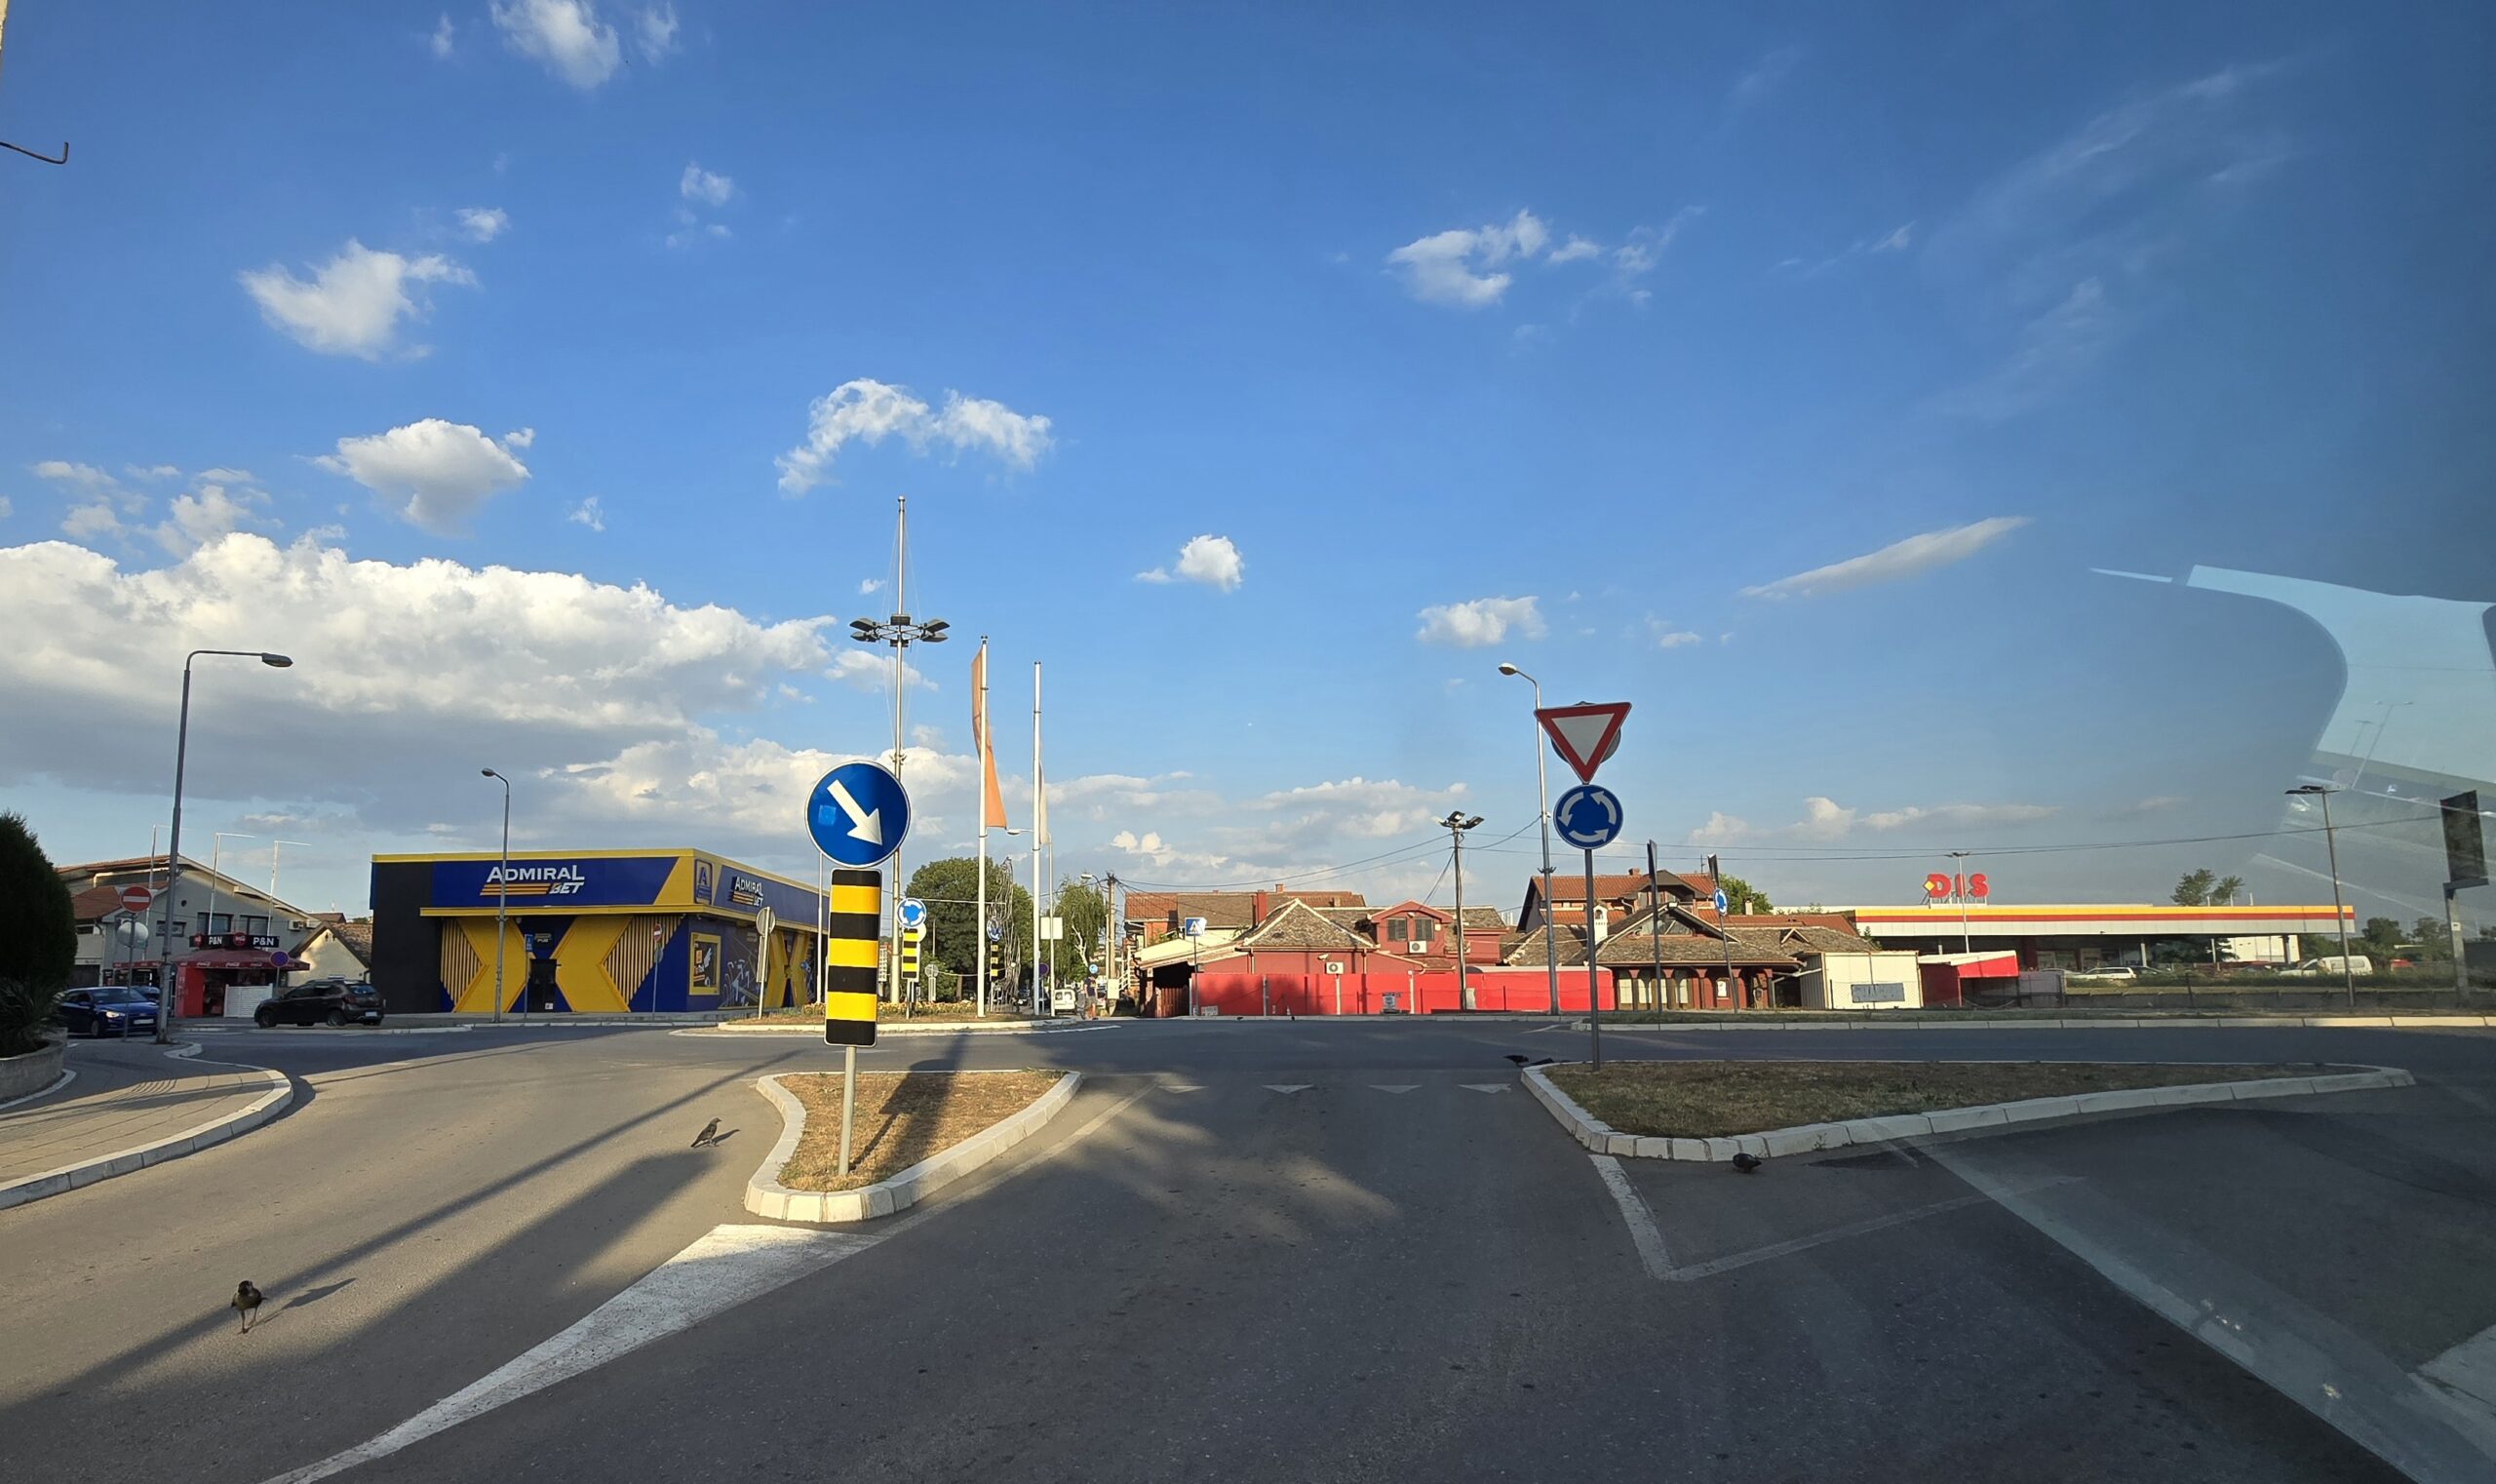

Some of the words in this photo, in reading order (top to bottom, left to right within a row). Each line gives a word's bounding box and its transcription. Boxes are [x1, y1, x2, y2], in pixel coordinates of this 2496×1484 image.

[486, 865, 585, 883] ADMIRAL
[548, 881, 585, 894] BET
[734, 876, 763, 897] ADMIRAL
[1927, 873, 1989, 898] DIS
[208, 936, 223, 946] P&N
[253, 936, 274, 946] P&N
